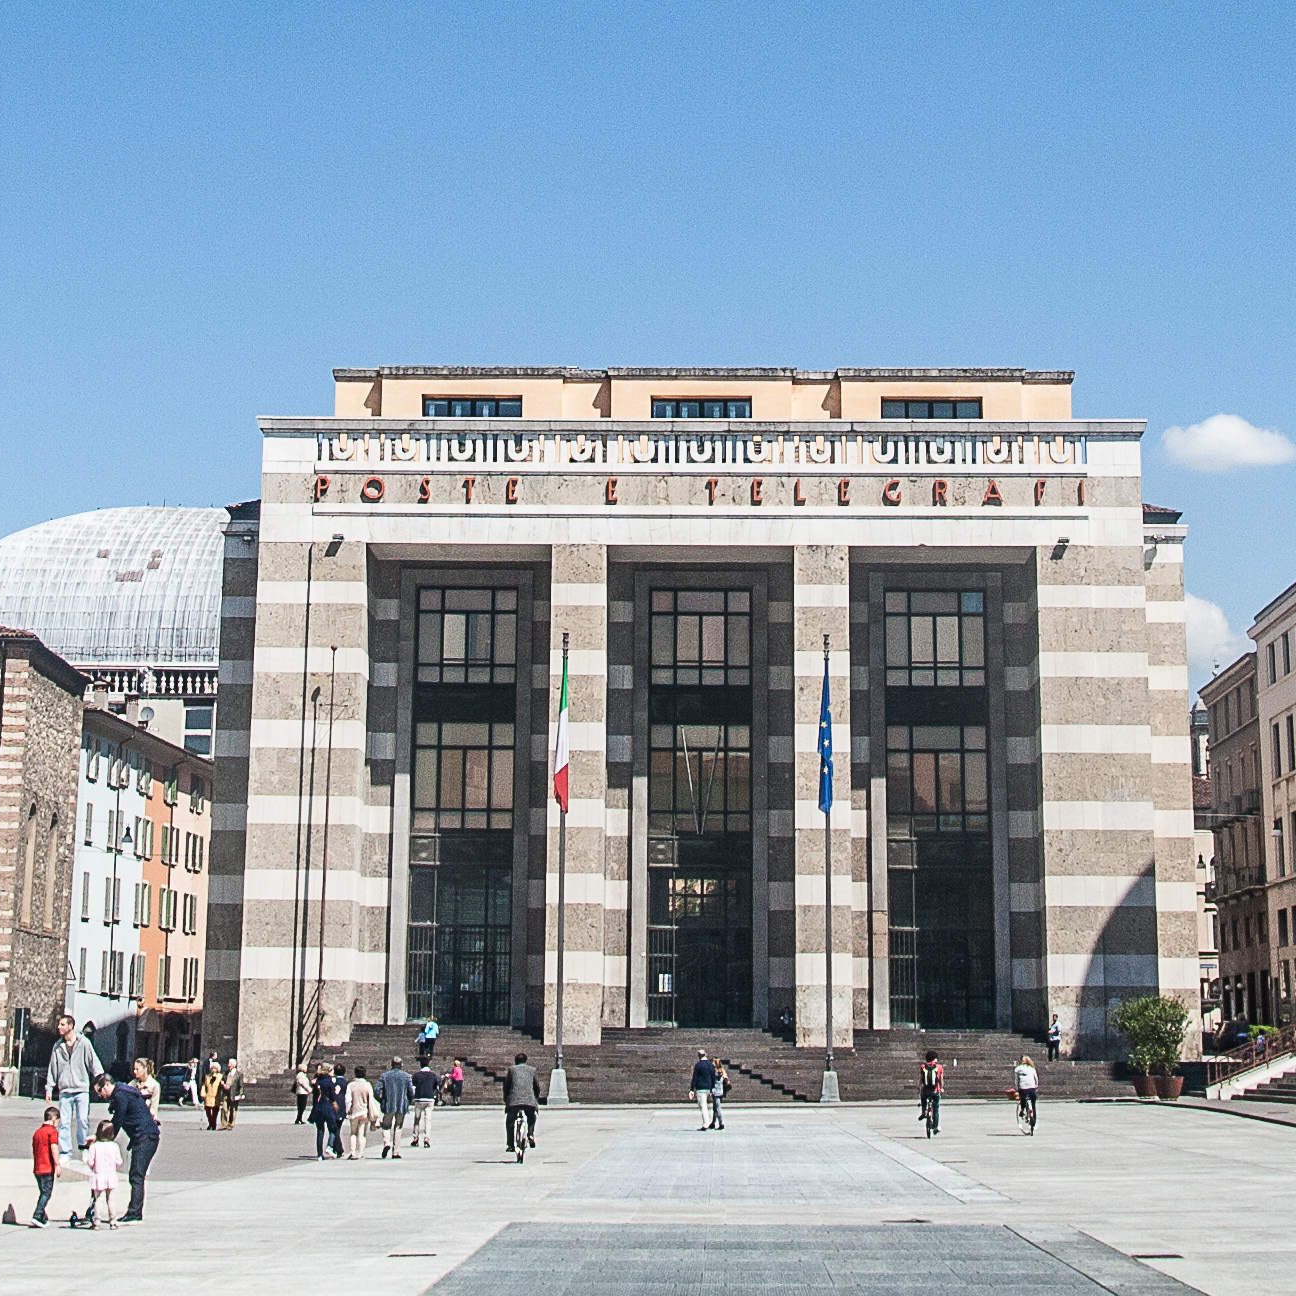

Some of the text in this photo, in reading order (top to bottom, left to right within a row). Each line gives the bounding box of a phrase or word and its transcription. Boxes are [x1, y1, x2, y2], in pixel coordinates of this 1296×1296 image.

[315, 475, 1086, 504] POSTE E TELEGRAFI
